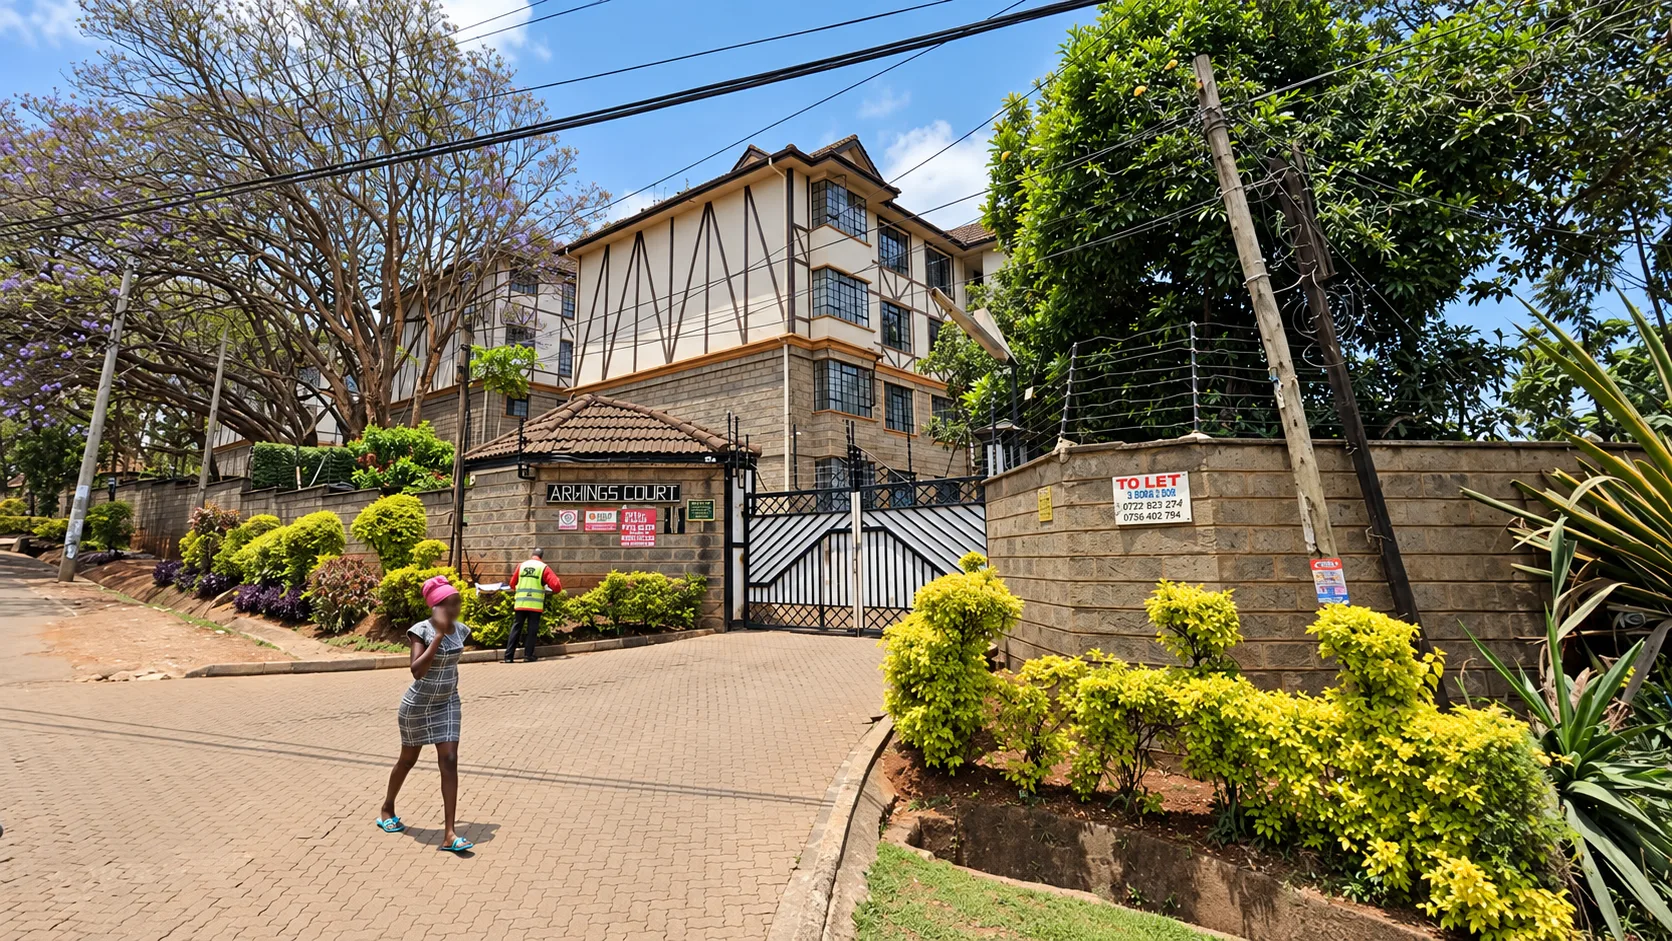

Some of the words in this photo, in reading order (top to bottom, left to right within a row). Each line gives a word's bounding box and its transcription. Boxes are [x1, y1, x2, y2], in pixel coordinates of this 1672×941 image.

[1116, 478, 1140, 490] TO
[1145, 474, 1181, 488] LET
[624, 485, 678, 501] COURT
[1127, 491, 1132, 499] 3
[1122, 502, 1144, 511] 0722
[1146, 501, 1163, 510] 823
[1165, 499, 1183, 508] 274
[1146, 511, 1162, 520] 402
[1165, 510, 1181, 520] 794
